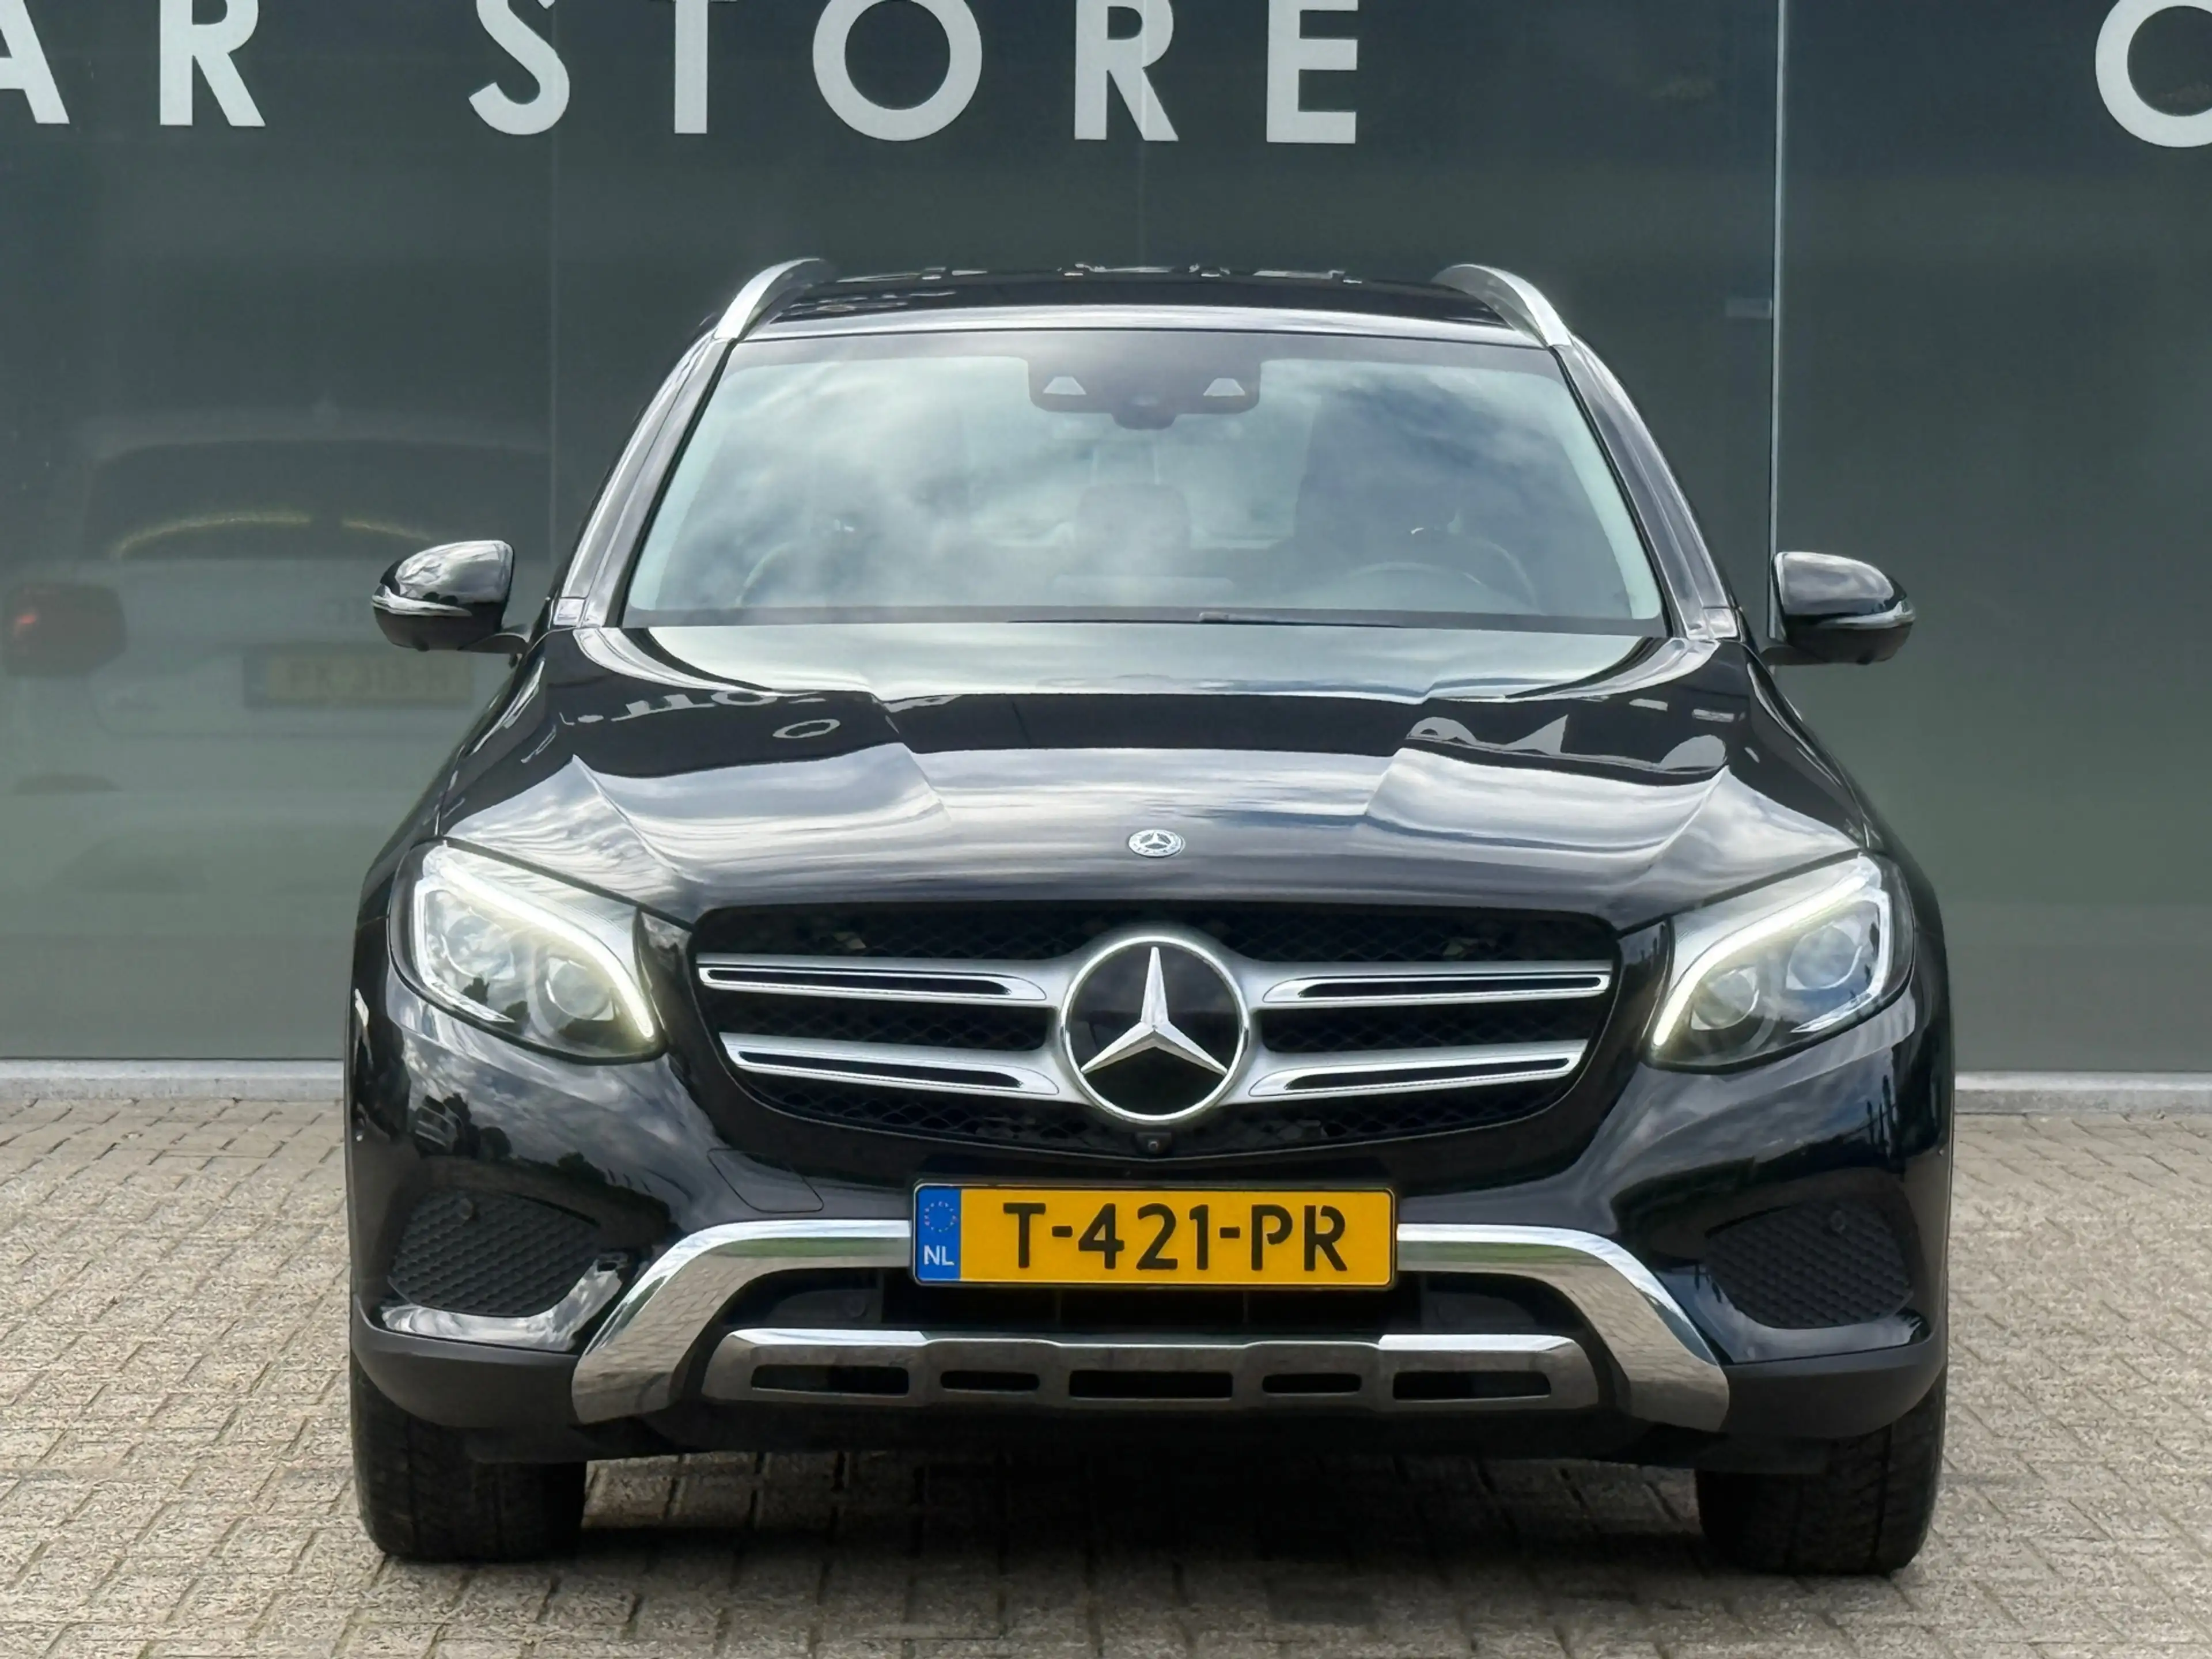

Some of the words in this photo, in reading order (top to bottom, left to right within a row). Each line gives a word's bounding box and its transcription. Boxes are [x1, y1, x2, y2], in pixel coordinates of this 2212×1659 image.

[469, 0, 1358, 143] STORE
[924, 1245, 954, 1265] NL
[1003, 1202, 1347, 1272] T-421-PR
